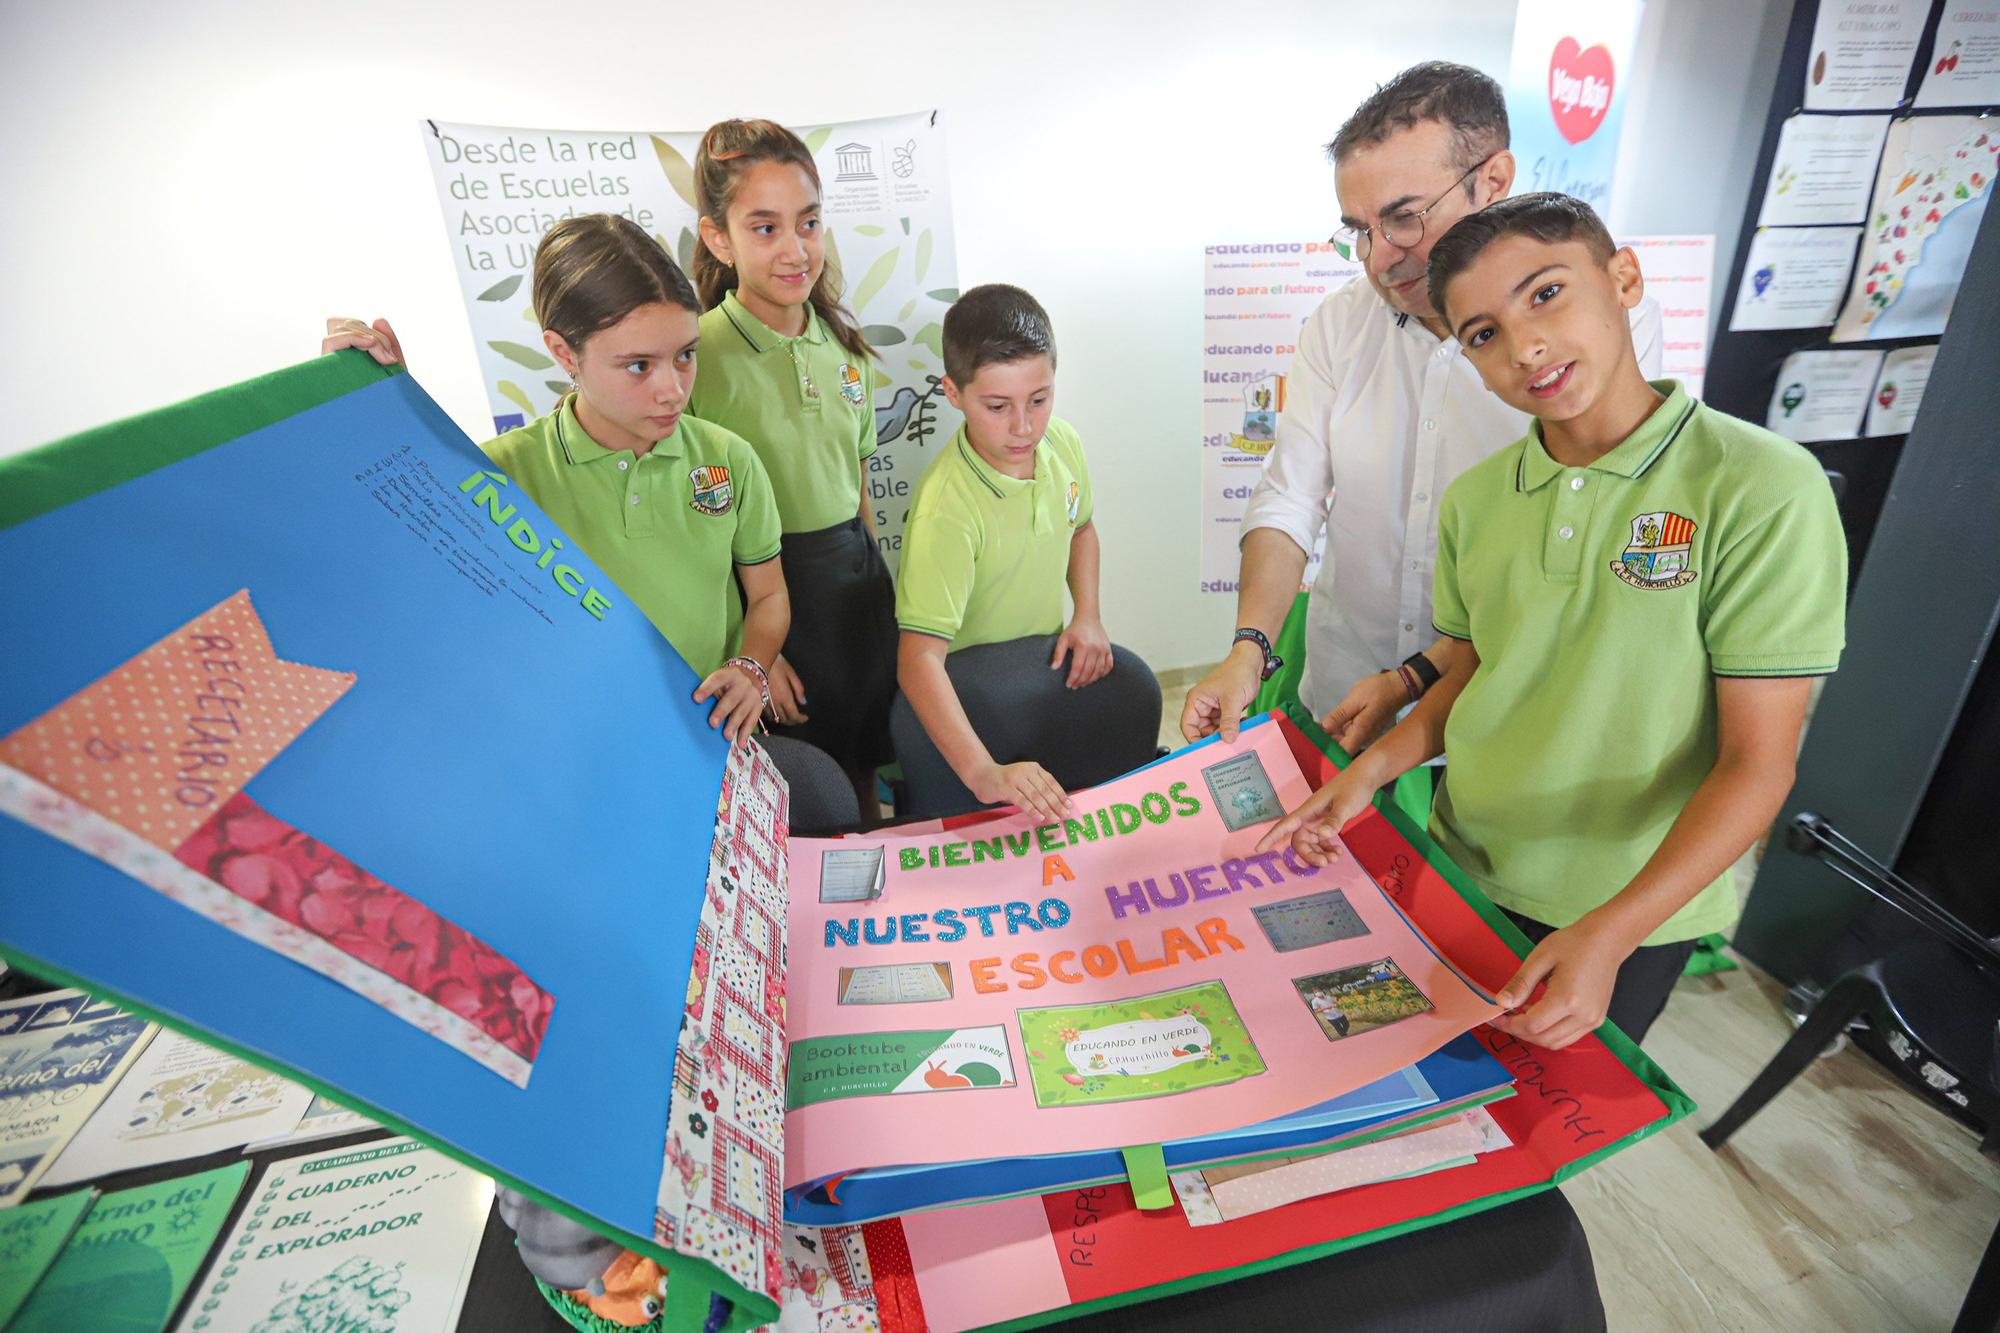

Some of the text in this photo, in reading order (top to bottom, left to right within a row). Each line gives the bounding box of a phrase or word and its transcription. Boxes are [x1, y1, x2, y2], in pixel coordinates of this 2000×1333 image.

[440, 136, 637, 164] Desde la red
[450, 170, 630, 200] de Escuelas
[465, 245, 497, 271] la
[1305, 241, 1335, 254] pa
[1237, 286, 1269, 297] para
[1270, 283, 1282, 295] el
[1284, 284, 1326, 294] futuro
[1275, 345, 1296, 355] pa
[869, 455, 893, 472] as
[872, 477, 909, 499] ble
[878, 535, 902, 551] na
[1201, 579, 1239, 593] educ
[176, 634, 245, 808] RECETARIO
[900, 781, 1201, 871] BIENVENIDOS
[1042, 854, 1077, 887] A
[824, 845, 1322, 948] NUESTRO HUERTO
[969, 917, 1247, 994] ESCOLAR
[806, 1041, 906, 1061] Booktube
[979, 1044, 1005, 1058] VERDE
[1073, 1026, 1200, 1052] EDUCANDO EN VERDE
[0, 1053, 113, 1090] erno del
[802, 1059, 909, 1083] ambiental
[315, 1150, 376, 1170] CUADERNO
[378, 1146, 400, 1157] DEL
[286, 1165, 417, 1201] CUADERNO
[81, 1181, 217, 1226] erno del
[271, 1210, 312, 1230] DEL
[256, 1212, 423, 1260] EXPLORADOR
